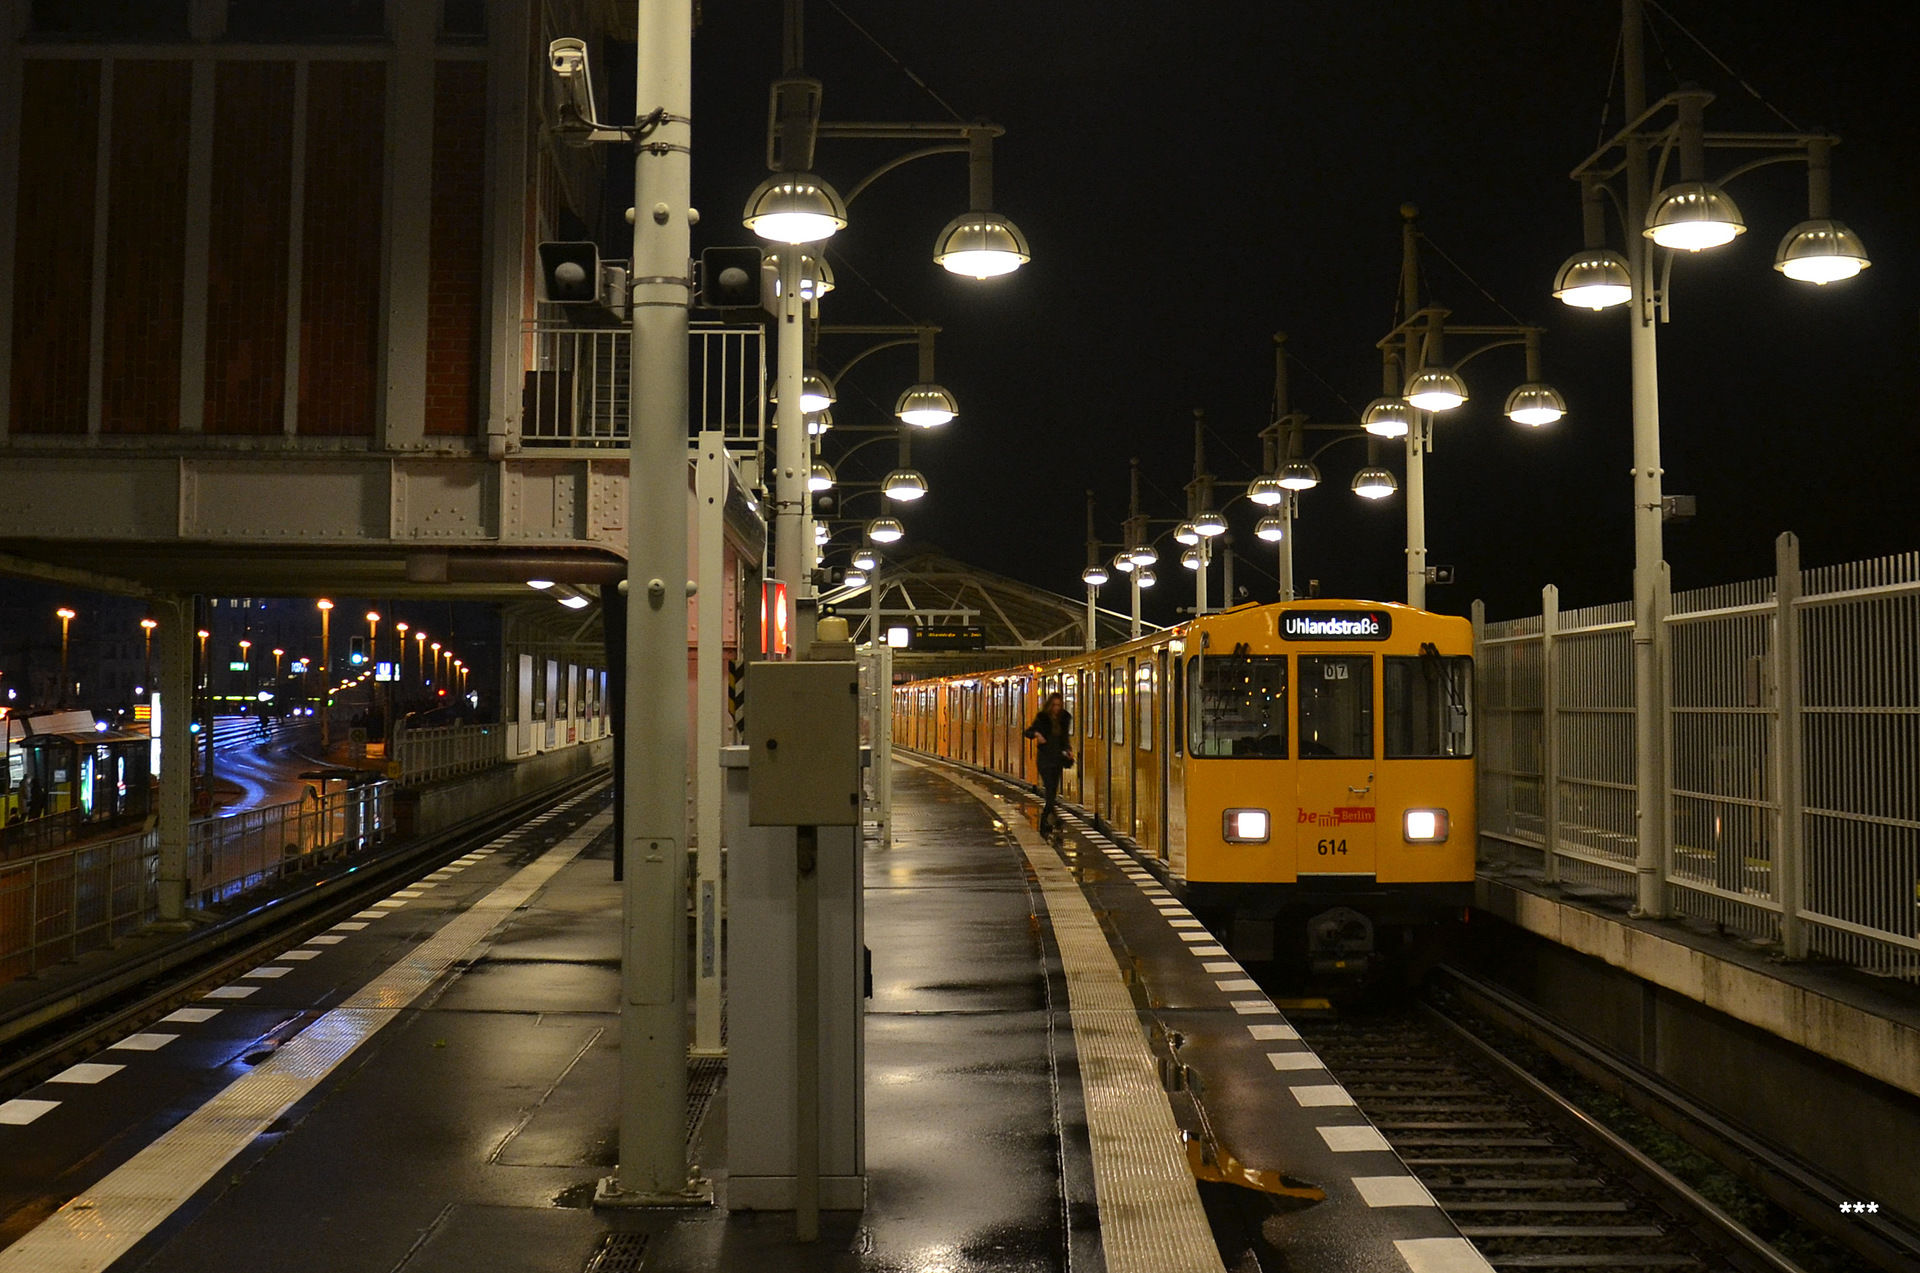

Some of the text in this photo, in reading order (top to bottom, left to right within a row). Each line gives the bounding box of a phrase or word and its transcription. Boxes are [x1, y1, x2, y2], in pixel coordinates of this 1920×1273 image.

[1286, 617, 1379, 635] Uhlandstraße
[380, 663, 391, 676] U
[1325, 664, 1347, 677] 07
[1297, 807, 1371, 823] be Berlin
[1317, 839, 1348, 855] 614
